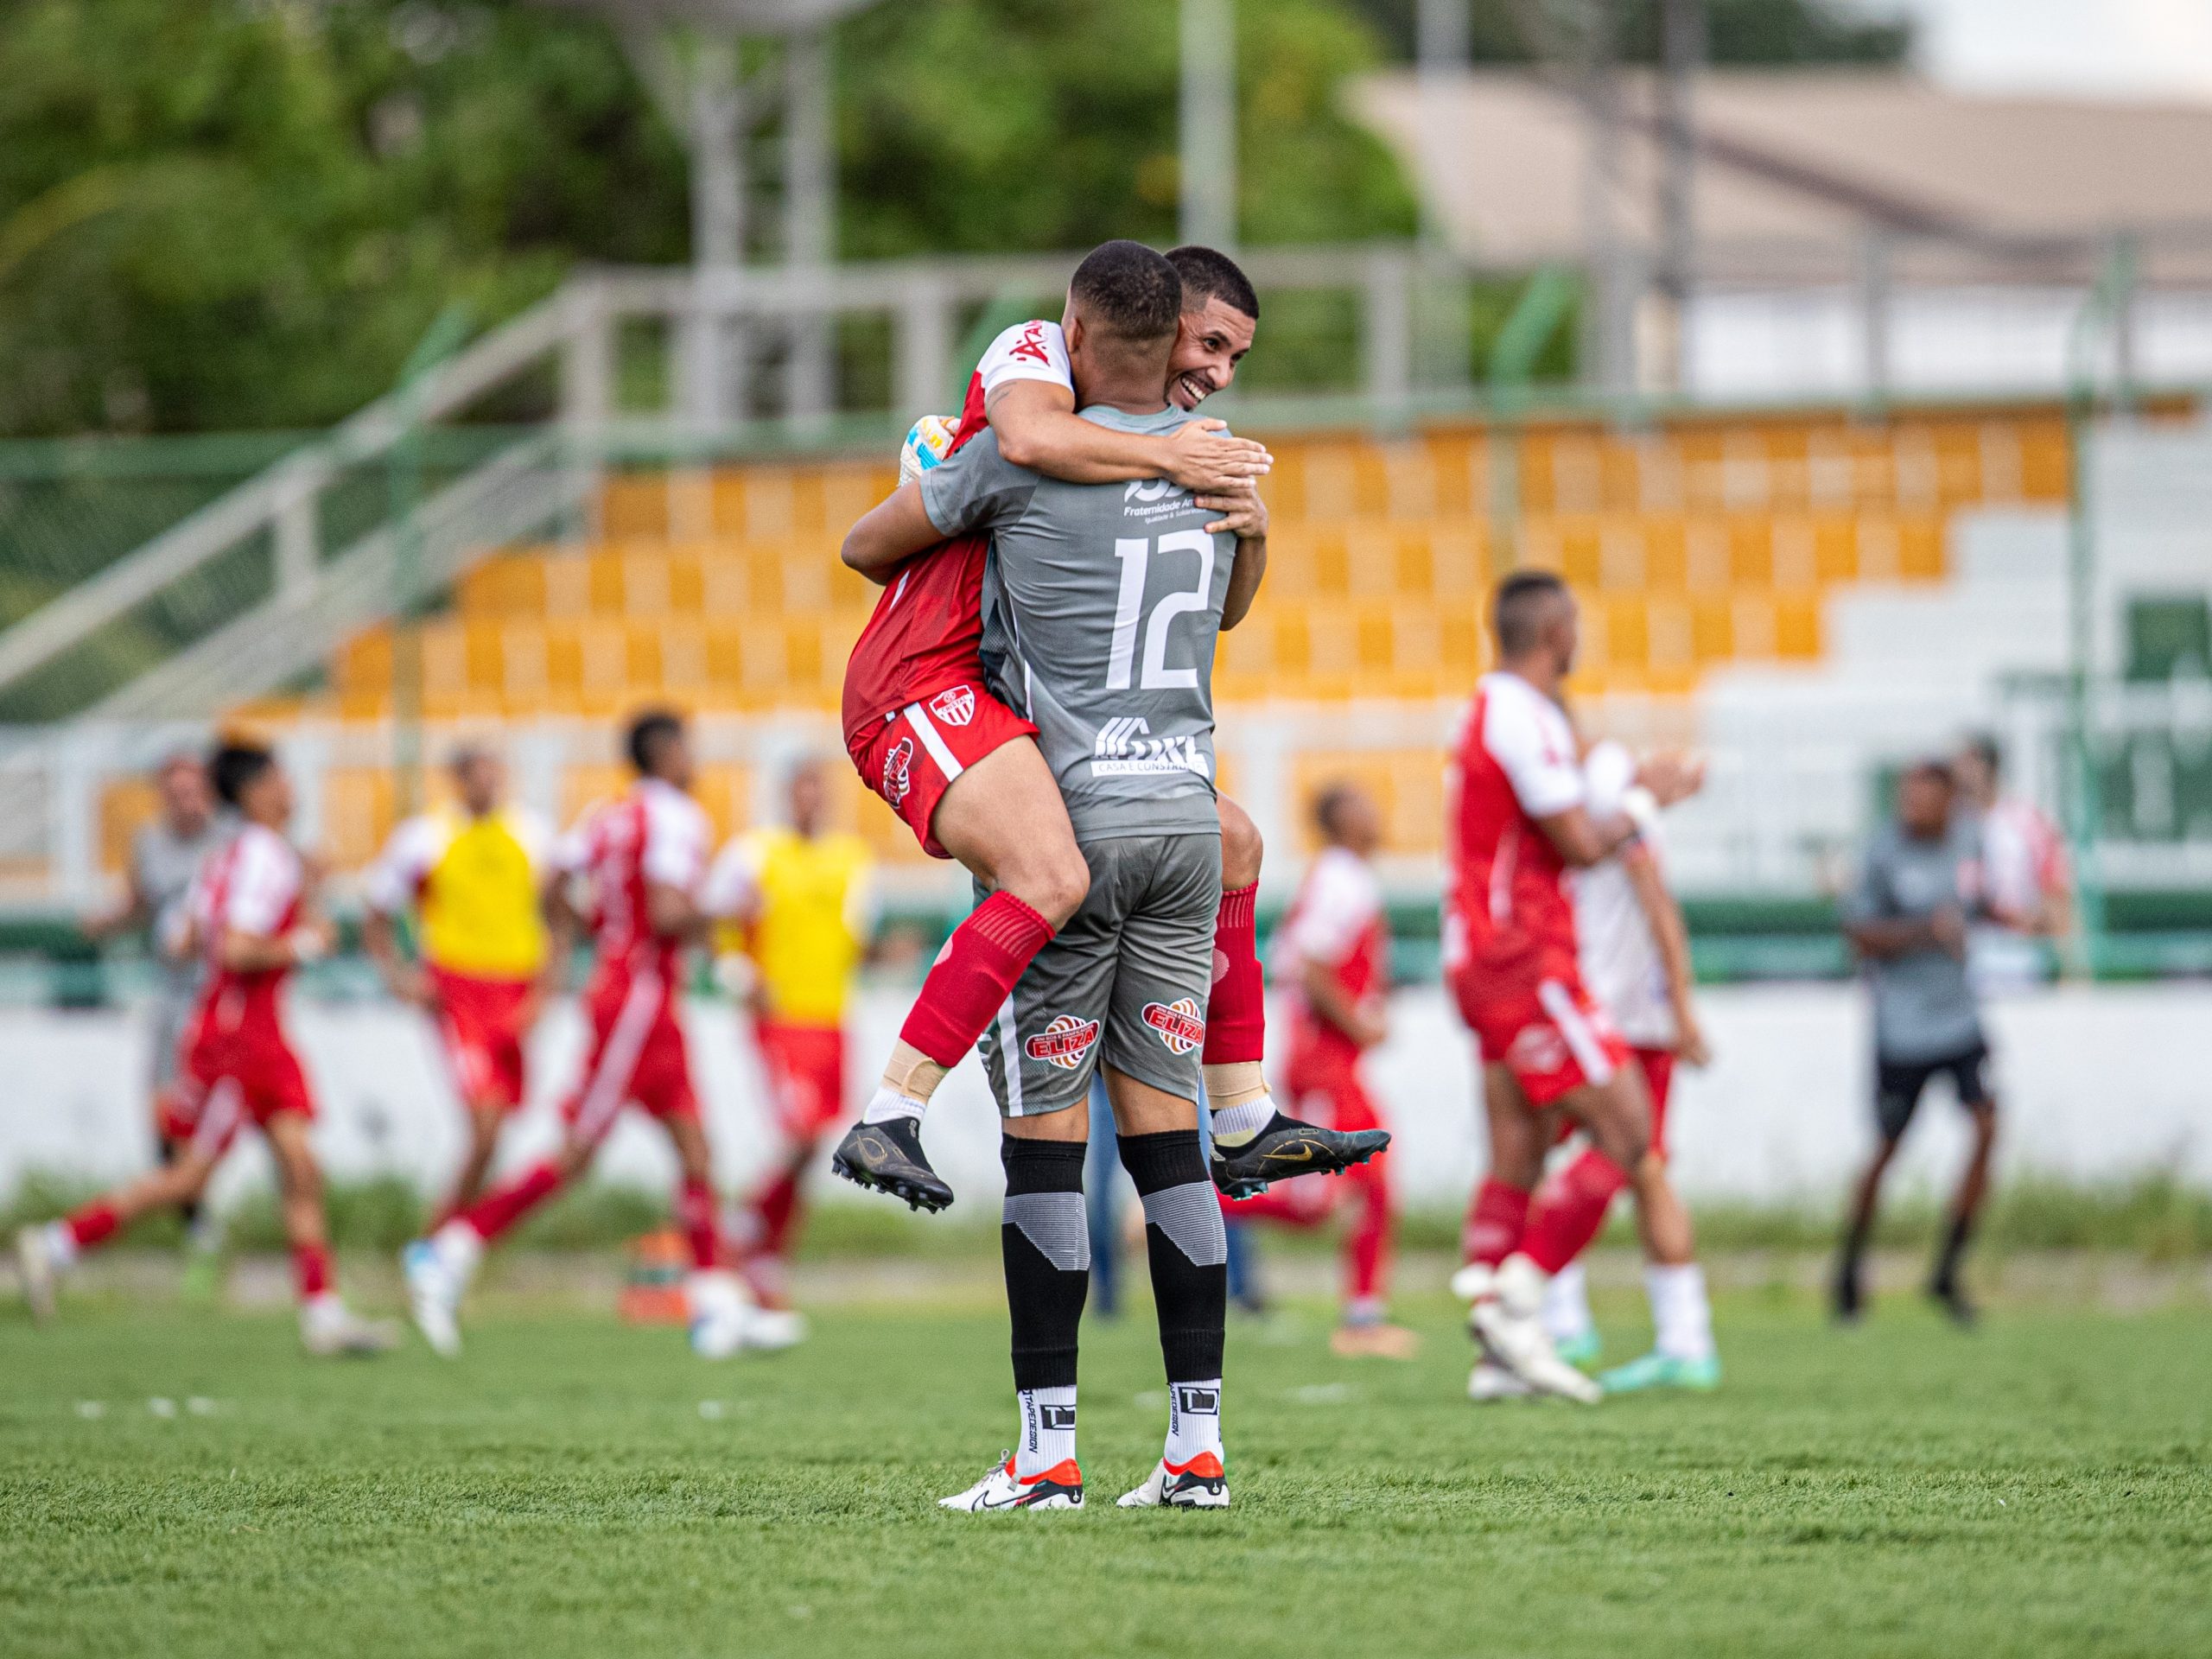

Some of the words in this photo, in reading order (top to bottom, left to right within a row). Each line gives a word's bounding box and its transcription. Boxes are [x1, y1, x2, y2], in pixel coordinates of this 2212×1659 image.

[1123, 501, 1181, 517] Fraternidade
[1105, 529, 1215, 690] 12
[1033, 1028, 1095, 1058] ELIZA
[1148, 1009, 1204, 1045] ELIZA
[1025, 1395, 1039, 1454] TAPEDESIGN
